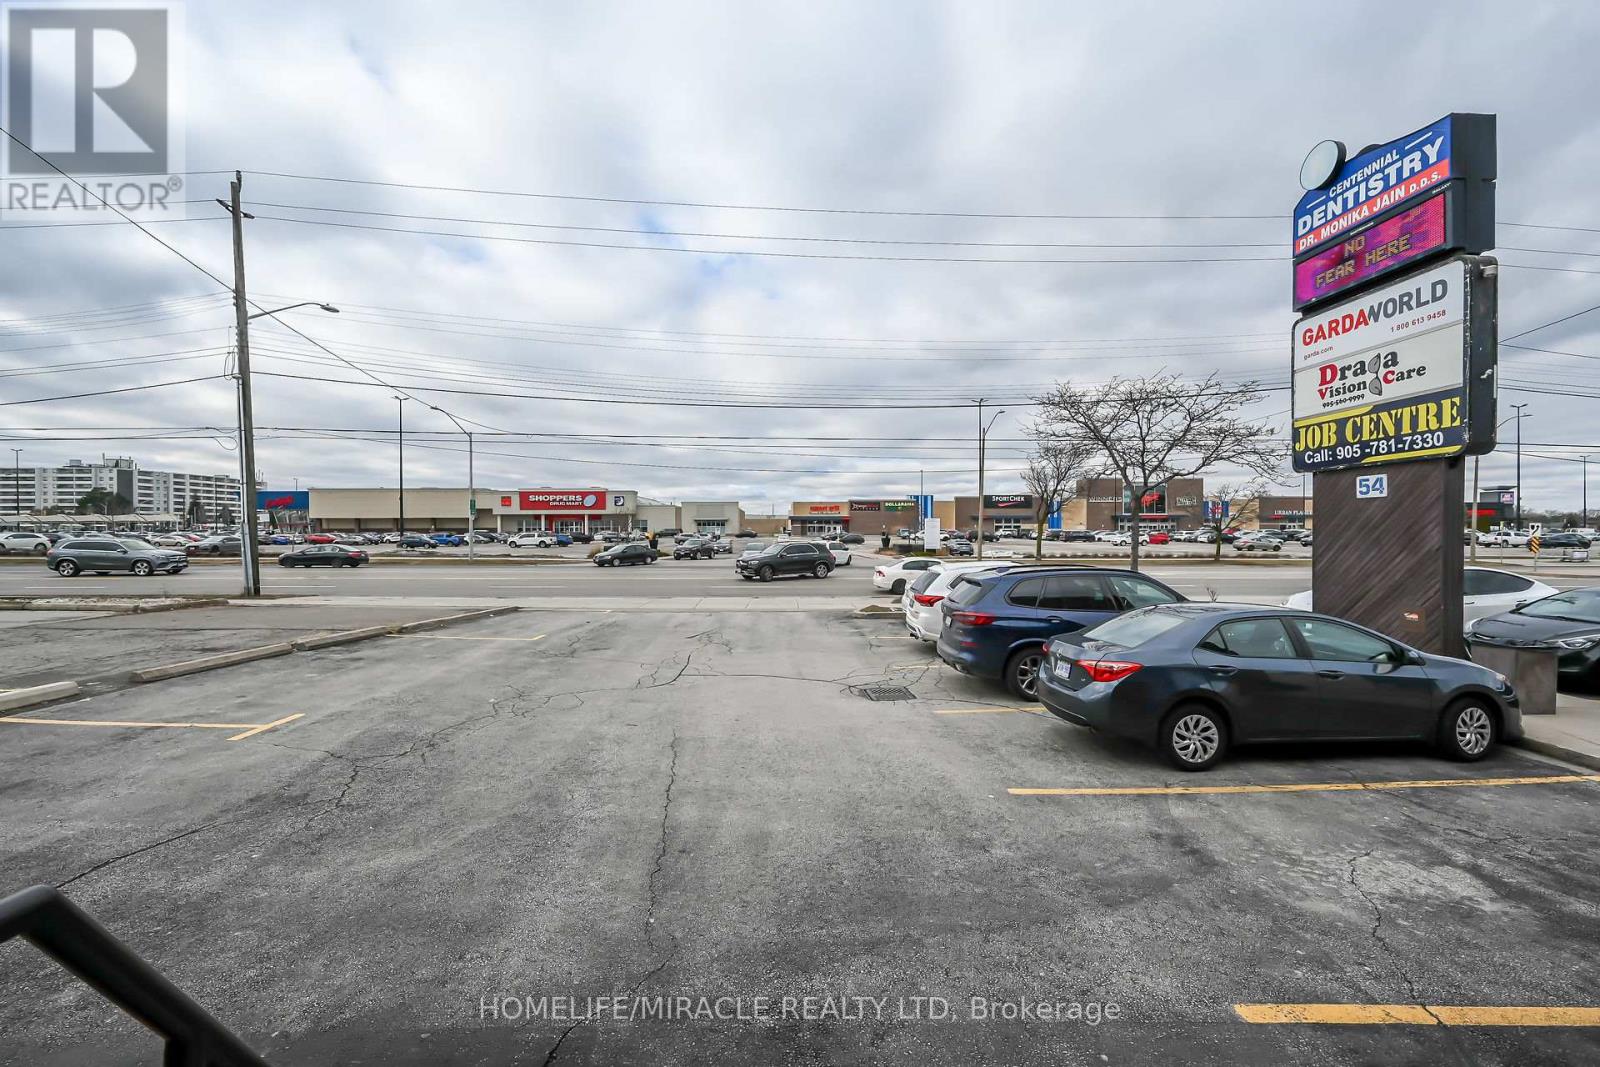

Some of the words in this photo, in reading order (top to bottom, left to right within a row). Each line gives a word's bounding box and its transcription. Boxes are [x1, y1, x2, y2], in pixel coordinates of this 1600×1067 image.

[1297, 136, 1444, 236] DENTISTRY
[1329, 149, 1400, 197] CENTENNIAL
[1299, 234, 1317, 251] DR.
[1320, 203, 1370, 239] MONIKA
[1373, 185, 1405, 212] JAIN
[1409, 170, 1441, 194] D.D.S.
[1315, 260, 1356, 288] FEAR
[1364, 233, 1412, 267] HERE
[1343, 236, 1365, 258] NO
[1302, 278, 1449, 346] GARDAWORLD
[1396, 320, 1410, 332] 800
[1411, 315, 1426, 327] 613
[1427, 309, 1447, 321] 9458
[1317, 380, 1368, 401] Vision
[1382, 364, 1427, 385] Care
[1295, 421, 1337, 451] JOB
[1345, 396, 1461, 443] CENTRE
[1304, 450, 1334, 464] Call:
[1336, 444, 1361, 459] 905
[528, 494, 583, 502] SHOPPERS
[1358, 477, 1385, 496] 54
